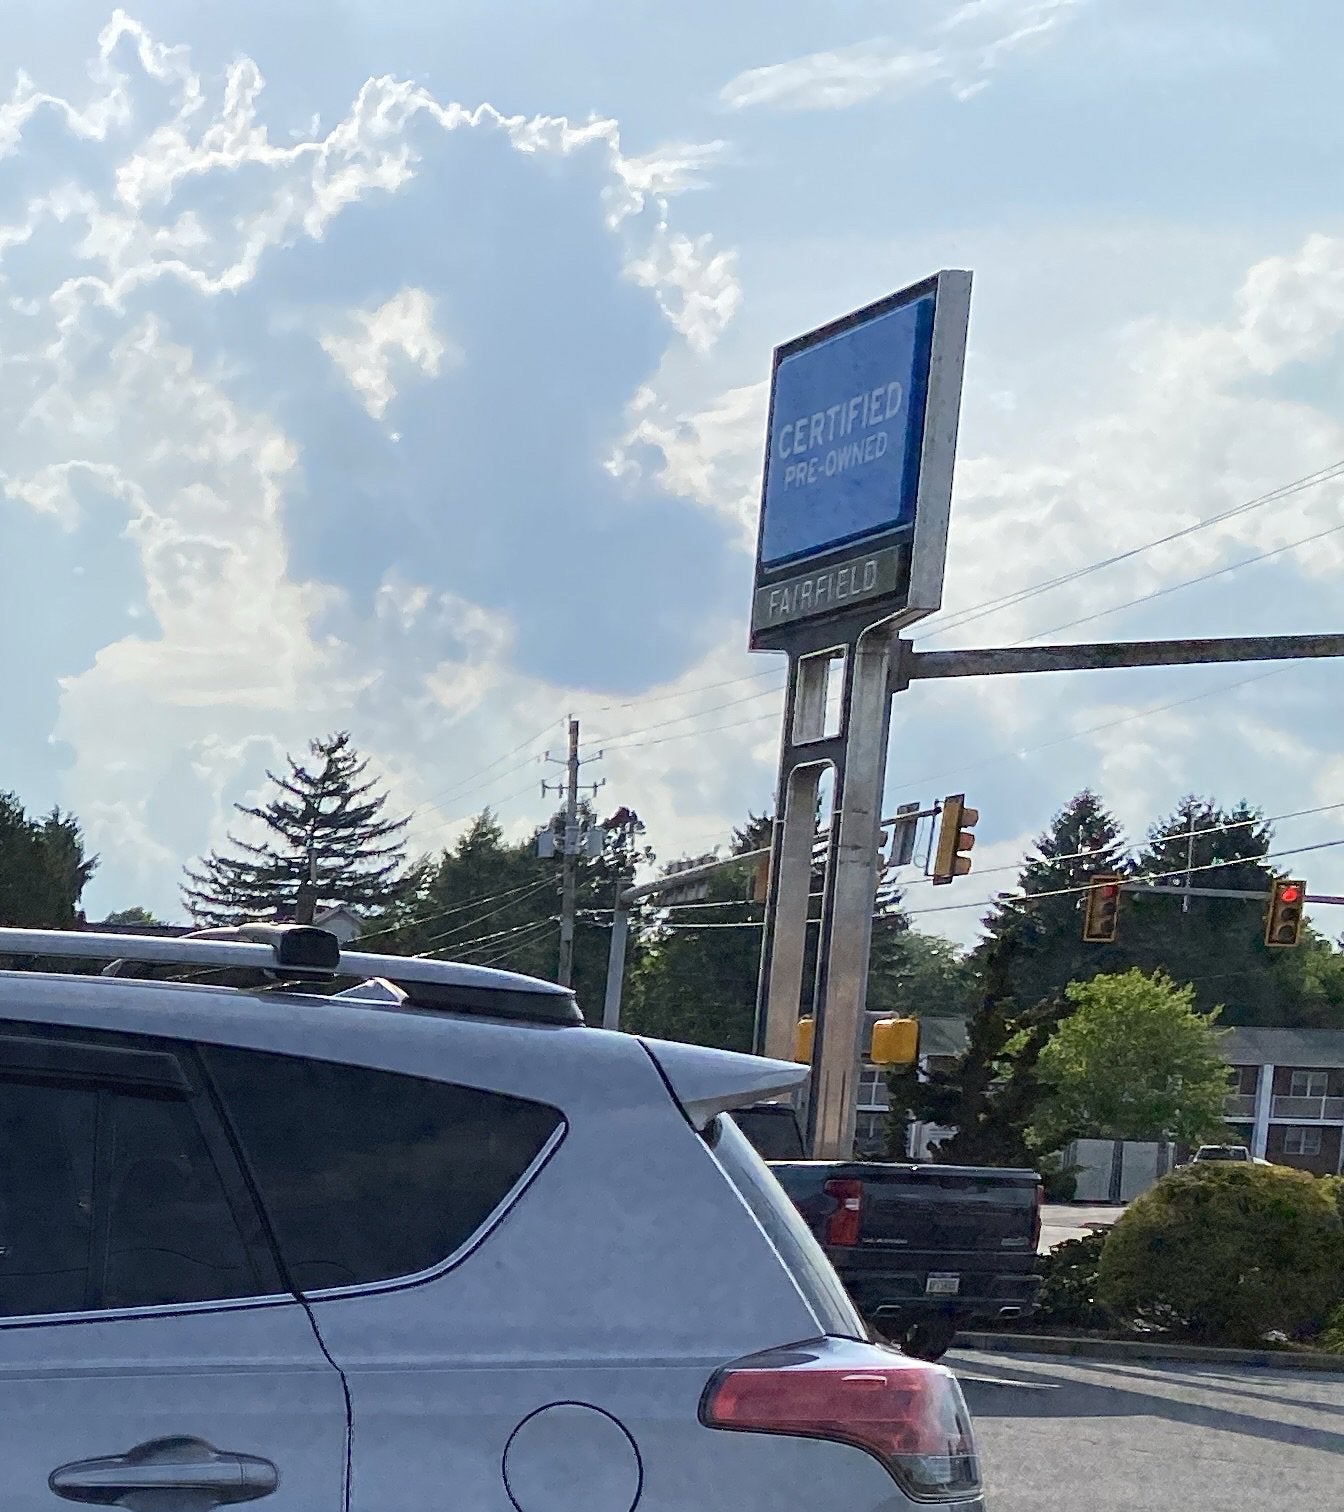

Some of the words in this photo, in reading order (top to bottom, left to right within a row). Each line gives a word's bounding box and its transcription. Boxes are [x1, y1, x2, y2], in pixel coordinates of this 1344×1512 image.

[778, 381, 902, 460] CERTIFIED
[784, 432, 889, 492] PRE-OWNED
[768, 560, 879, 619] FAIRFIELD
